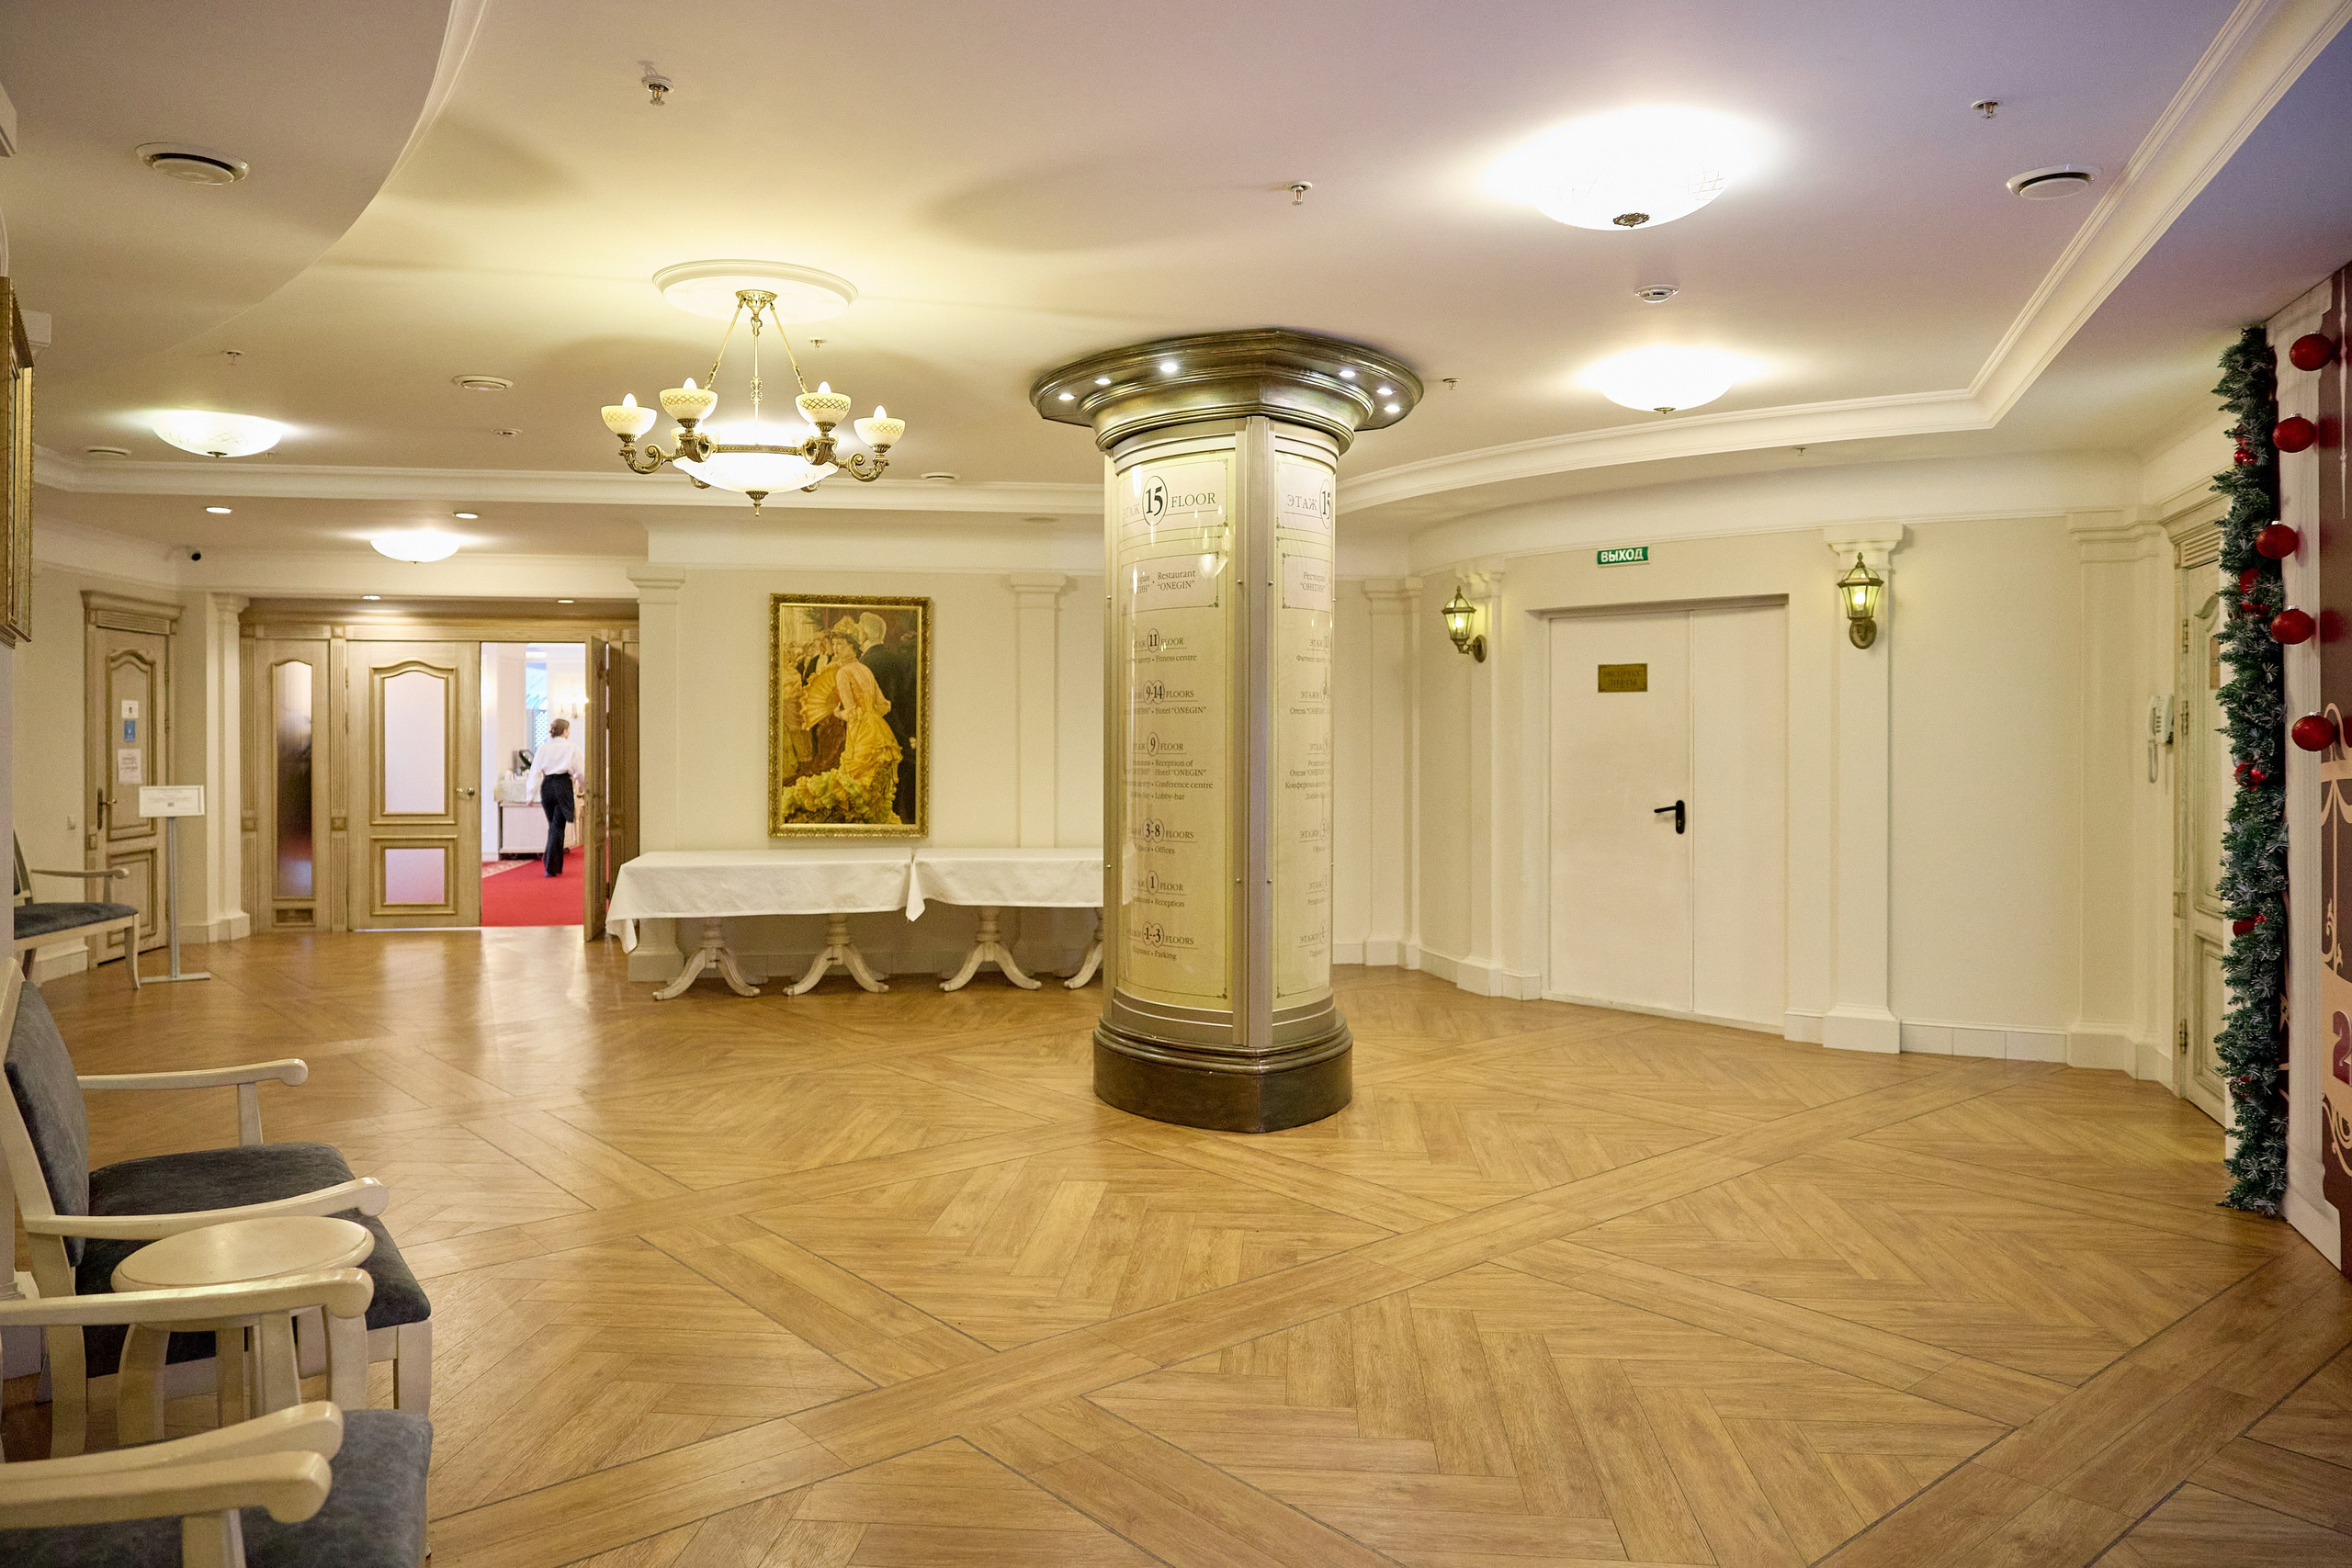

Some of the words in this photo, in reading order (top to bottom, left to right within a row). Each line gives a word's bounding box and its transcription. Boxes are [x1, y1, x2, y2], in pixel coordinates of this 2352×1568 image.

[1146, 486, 1163, 516] 15
[1171, 492, 1216, 508] FLOOR
[1287, 494, 1317, 511] ЭТАЖ
[1600, 548, 1644, 562] ВЫХОД
[1158, 570, 1195, 581] Restaurant
[1158, 581, 1195, 591] "ONEGIN"
[1149, 634, 1157, 647] 11
[1161, 637, 1183, 646] FLOOR
[1146, 685, 1162, 700] 9-14
[1150, 738, 1156, 752] 9
[1155, 760, 1184, 768] Reception
[1155, 792, 1184, 801] Lobby-bar
[1146, 823, 1160, 838] 3-8
[1155, 846, 1175, 854] Offices
[1151, 876, 1155, 889] 1
[1160, 883, 1183, 891] FLOOR
[1155, 897, 1184, 908] Reception
[1166, 935, 1194, 944] FLOORS
[1155, 950, 1177, 960] Parking
